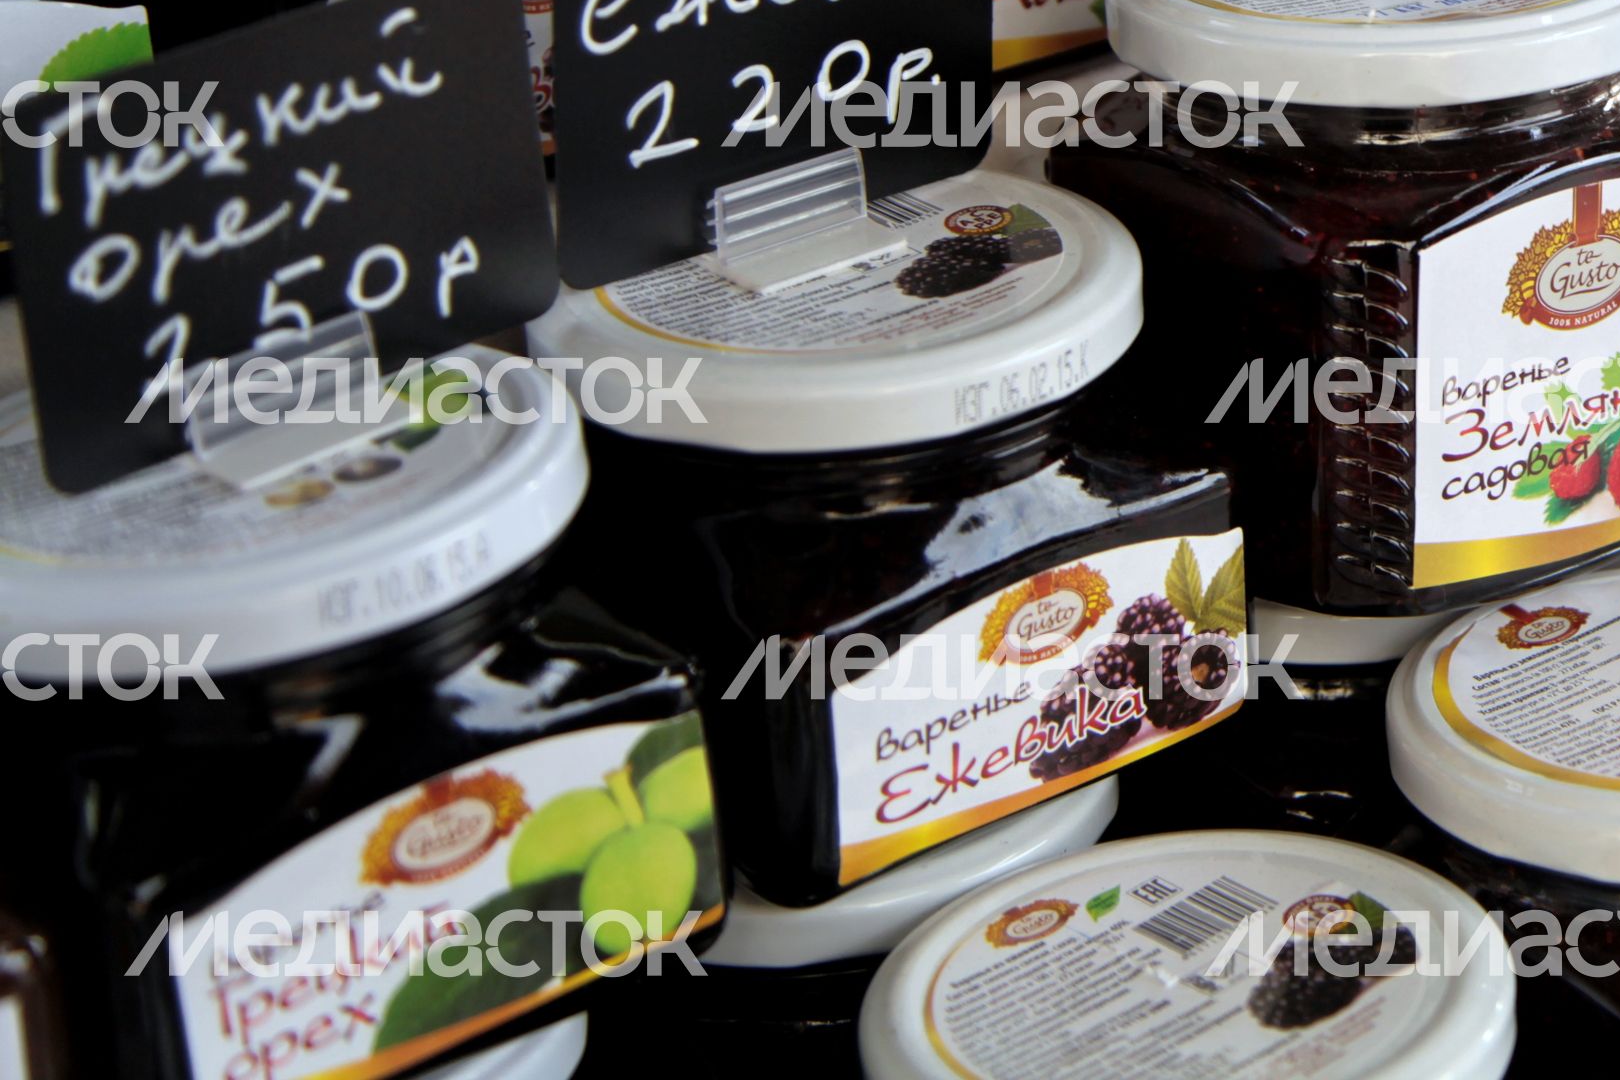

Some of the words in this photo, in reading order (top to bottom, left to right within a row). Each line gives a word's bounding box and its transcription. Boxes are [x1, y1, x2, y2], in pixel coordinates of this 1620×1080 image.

[69, 163, 350, 304] орех
[1577, 247, 1602, 265] te
[1574, 301, 1618, 326] NATURAL
[1441, 437, 1592, 501] садовая
[1017, 607, 1078, 640] Gusto
[876, 684, 1148, 824] Ежевика
